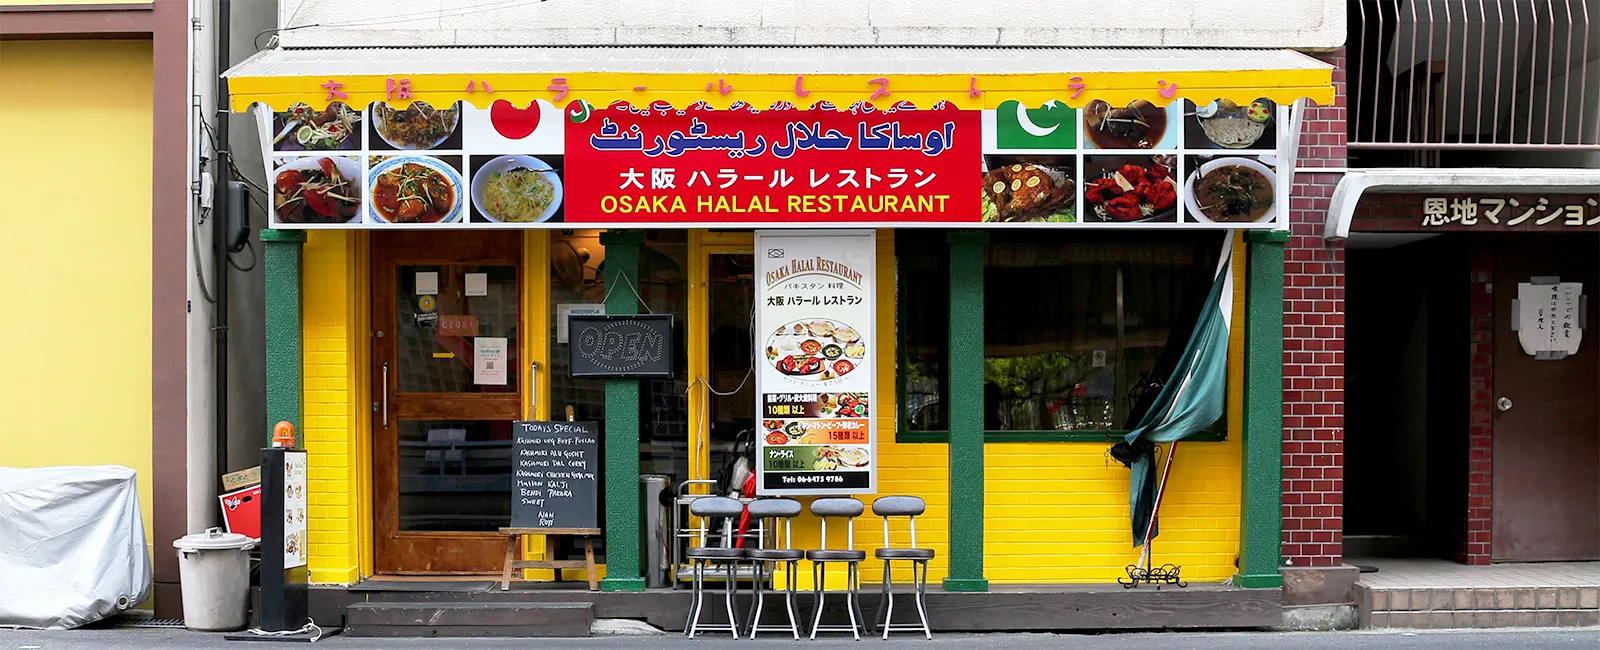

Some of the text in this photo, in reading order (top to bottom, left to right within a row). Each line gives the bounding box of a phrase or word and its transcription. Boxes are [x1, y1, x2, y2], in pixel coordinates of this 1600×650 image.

[771, 120, 853, 158] حلال
[619, 167, 936, 189] 大阪 ハラール レストラン
[600, 194, 950, 214] OSAKA HALAL RESTAURANT
[828, 282, 844, 290] 料理
[767, 295, 863, 306] 大阪 ハラール レストラン
[578, 326, 664, 363] OPEN
[791, 405, 805, 415] 以上
[553, 423, 588, 434] SPECIAL
[852, 431, 865, 440] 以上
[521, 498, 545, 508] SWEET
[538, 511, 554, 519] NAN
